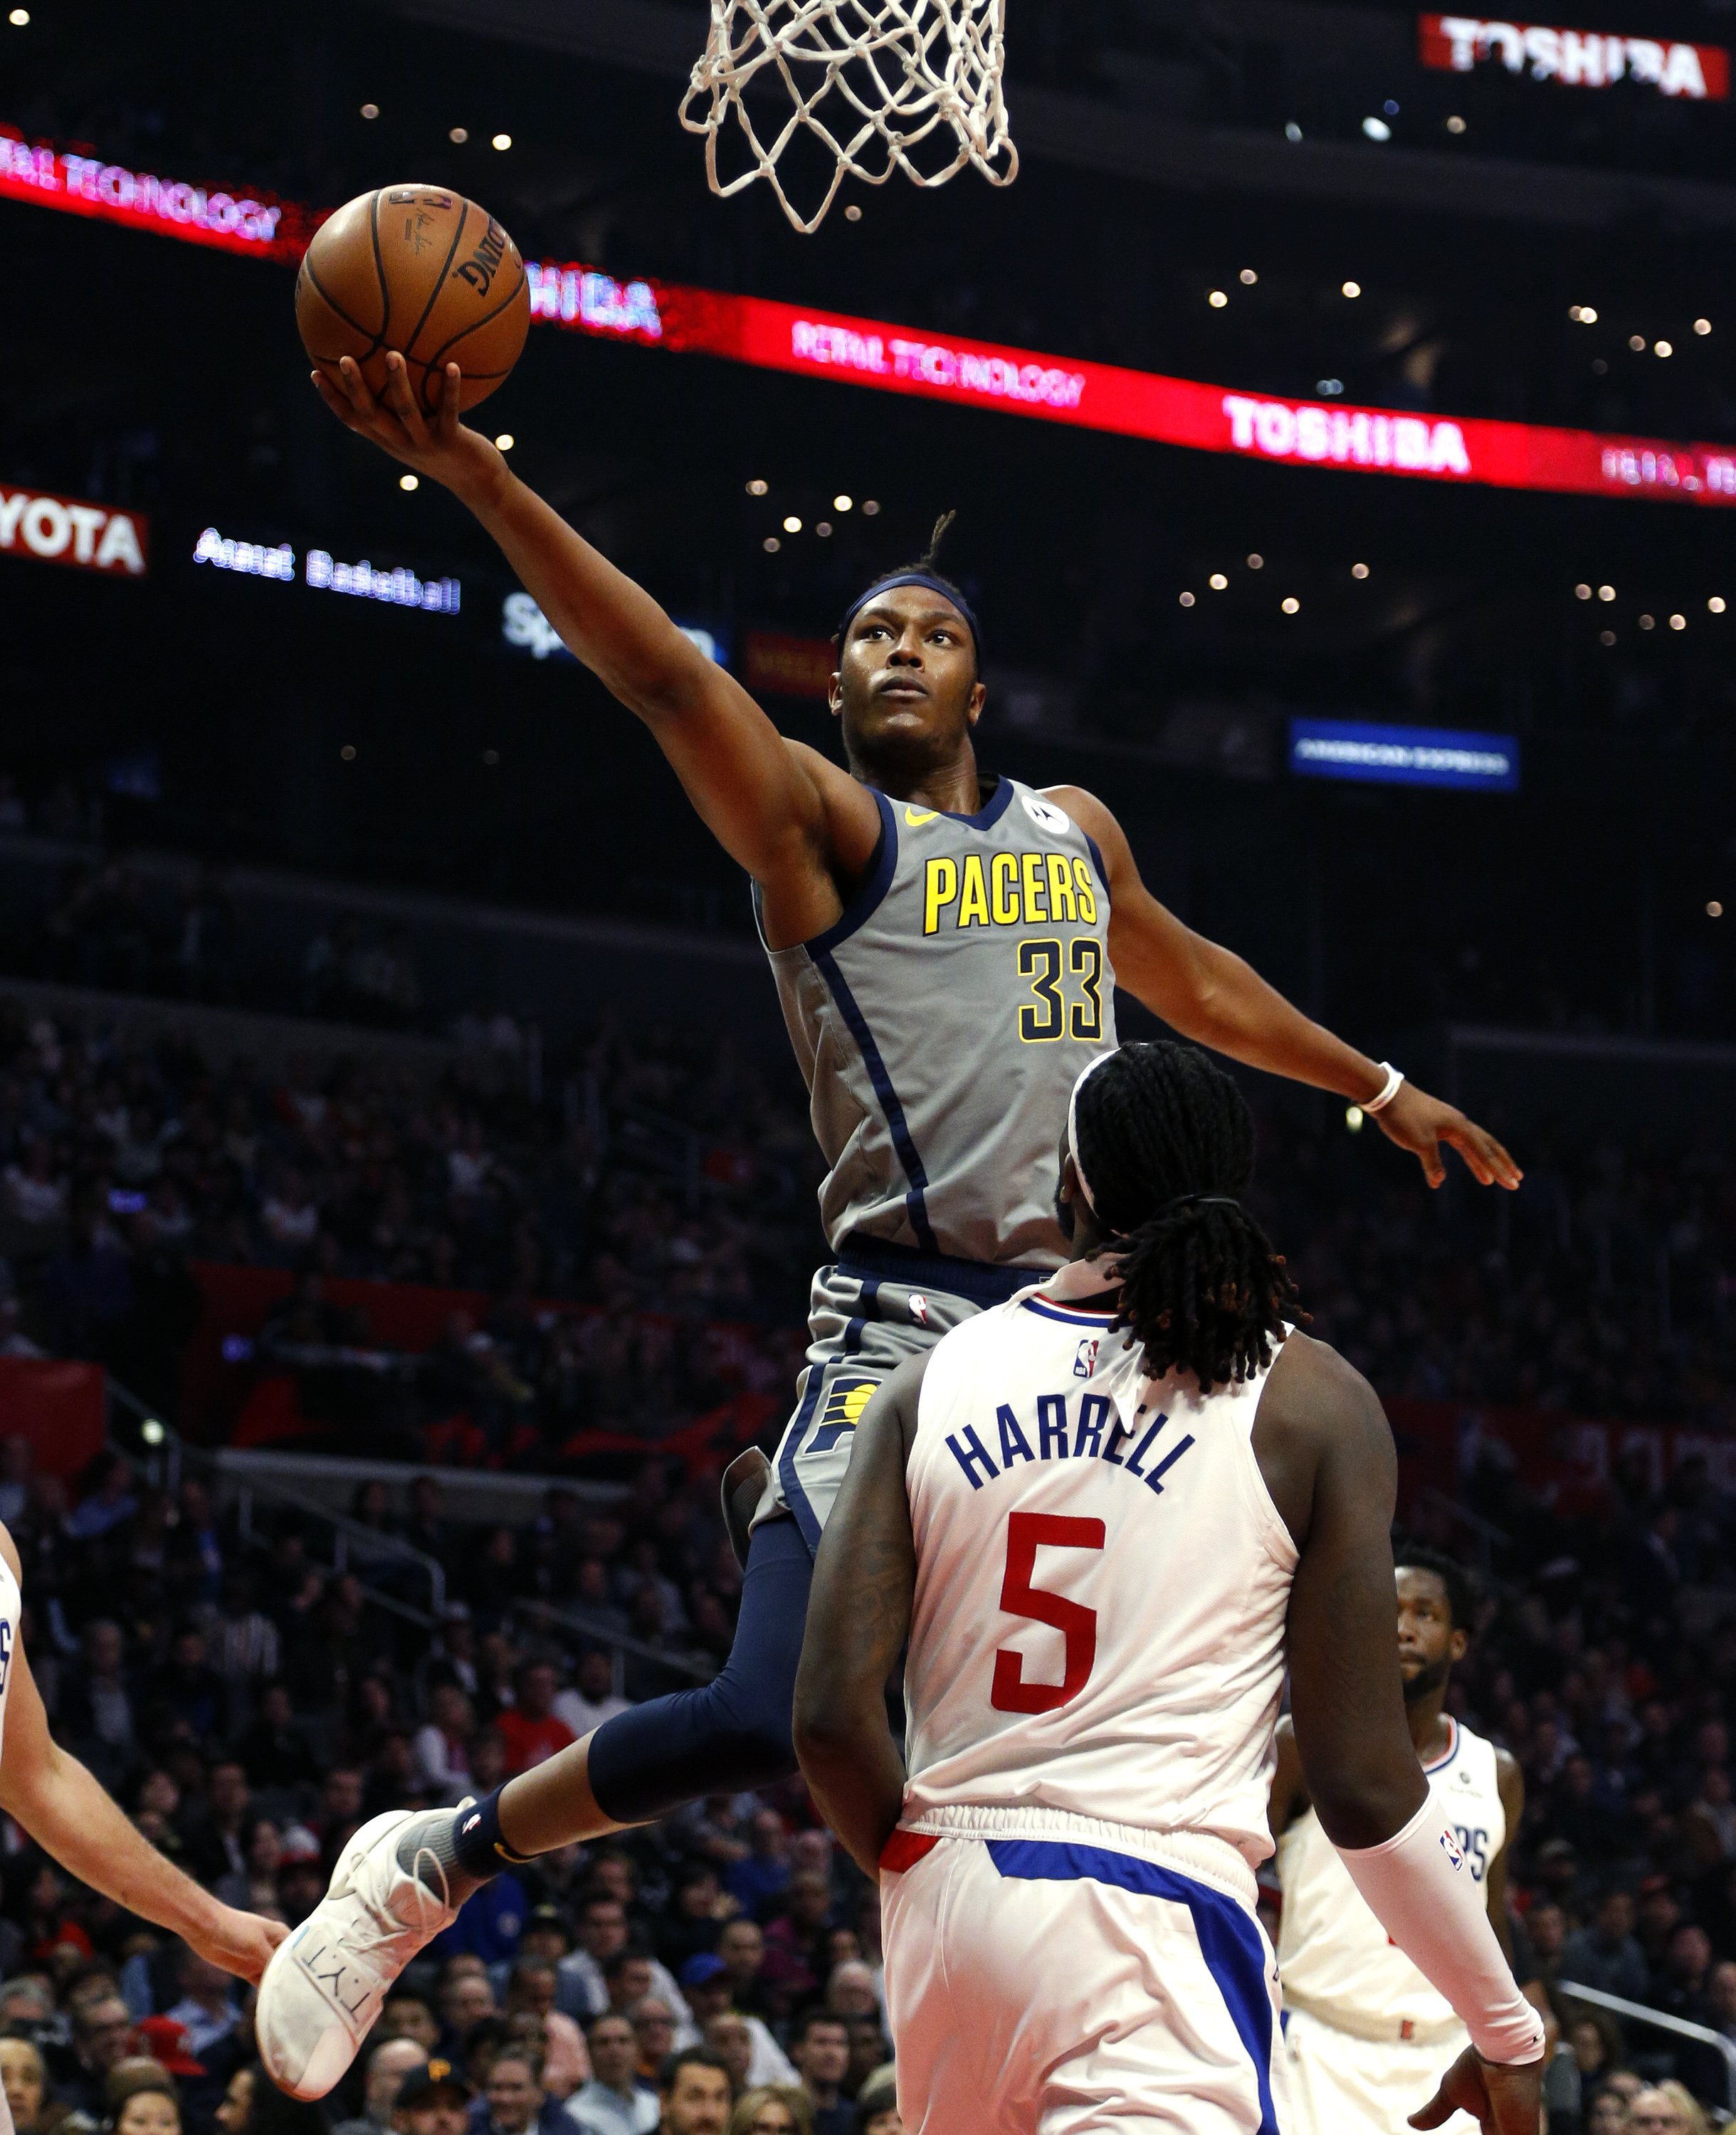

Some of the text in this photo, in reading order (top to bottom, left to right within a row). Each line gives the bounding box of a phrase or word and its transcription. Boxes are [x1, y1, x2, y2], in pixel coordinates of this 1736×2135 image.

[1440, 16, 1708, 98] TOSHIBA
[1222, 394, 1471, 475] TOSHIBA
[923, 852, 1097, 937] PACERS
[1017, 937, 1103, 1043] 33
[945, 1393, 1196, 1494] HARRELL
[991, 1512, 1106, 1715] 5
